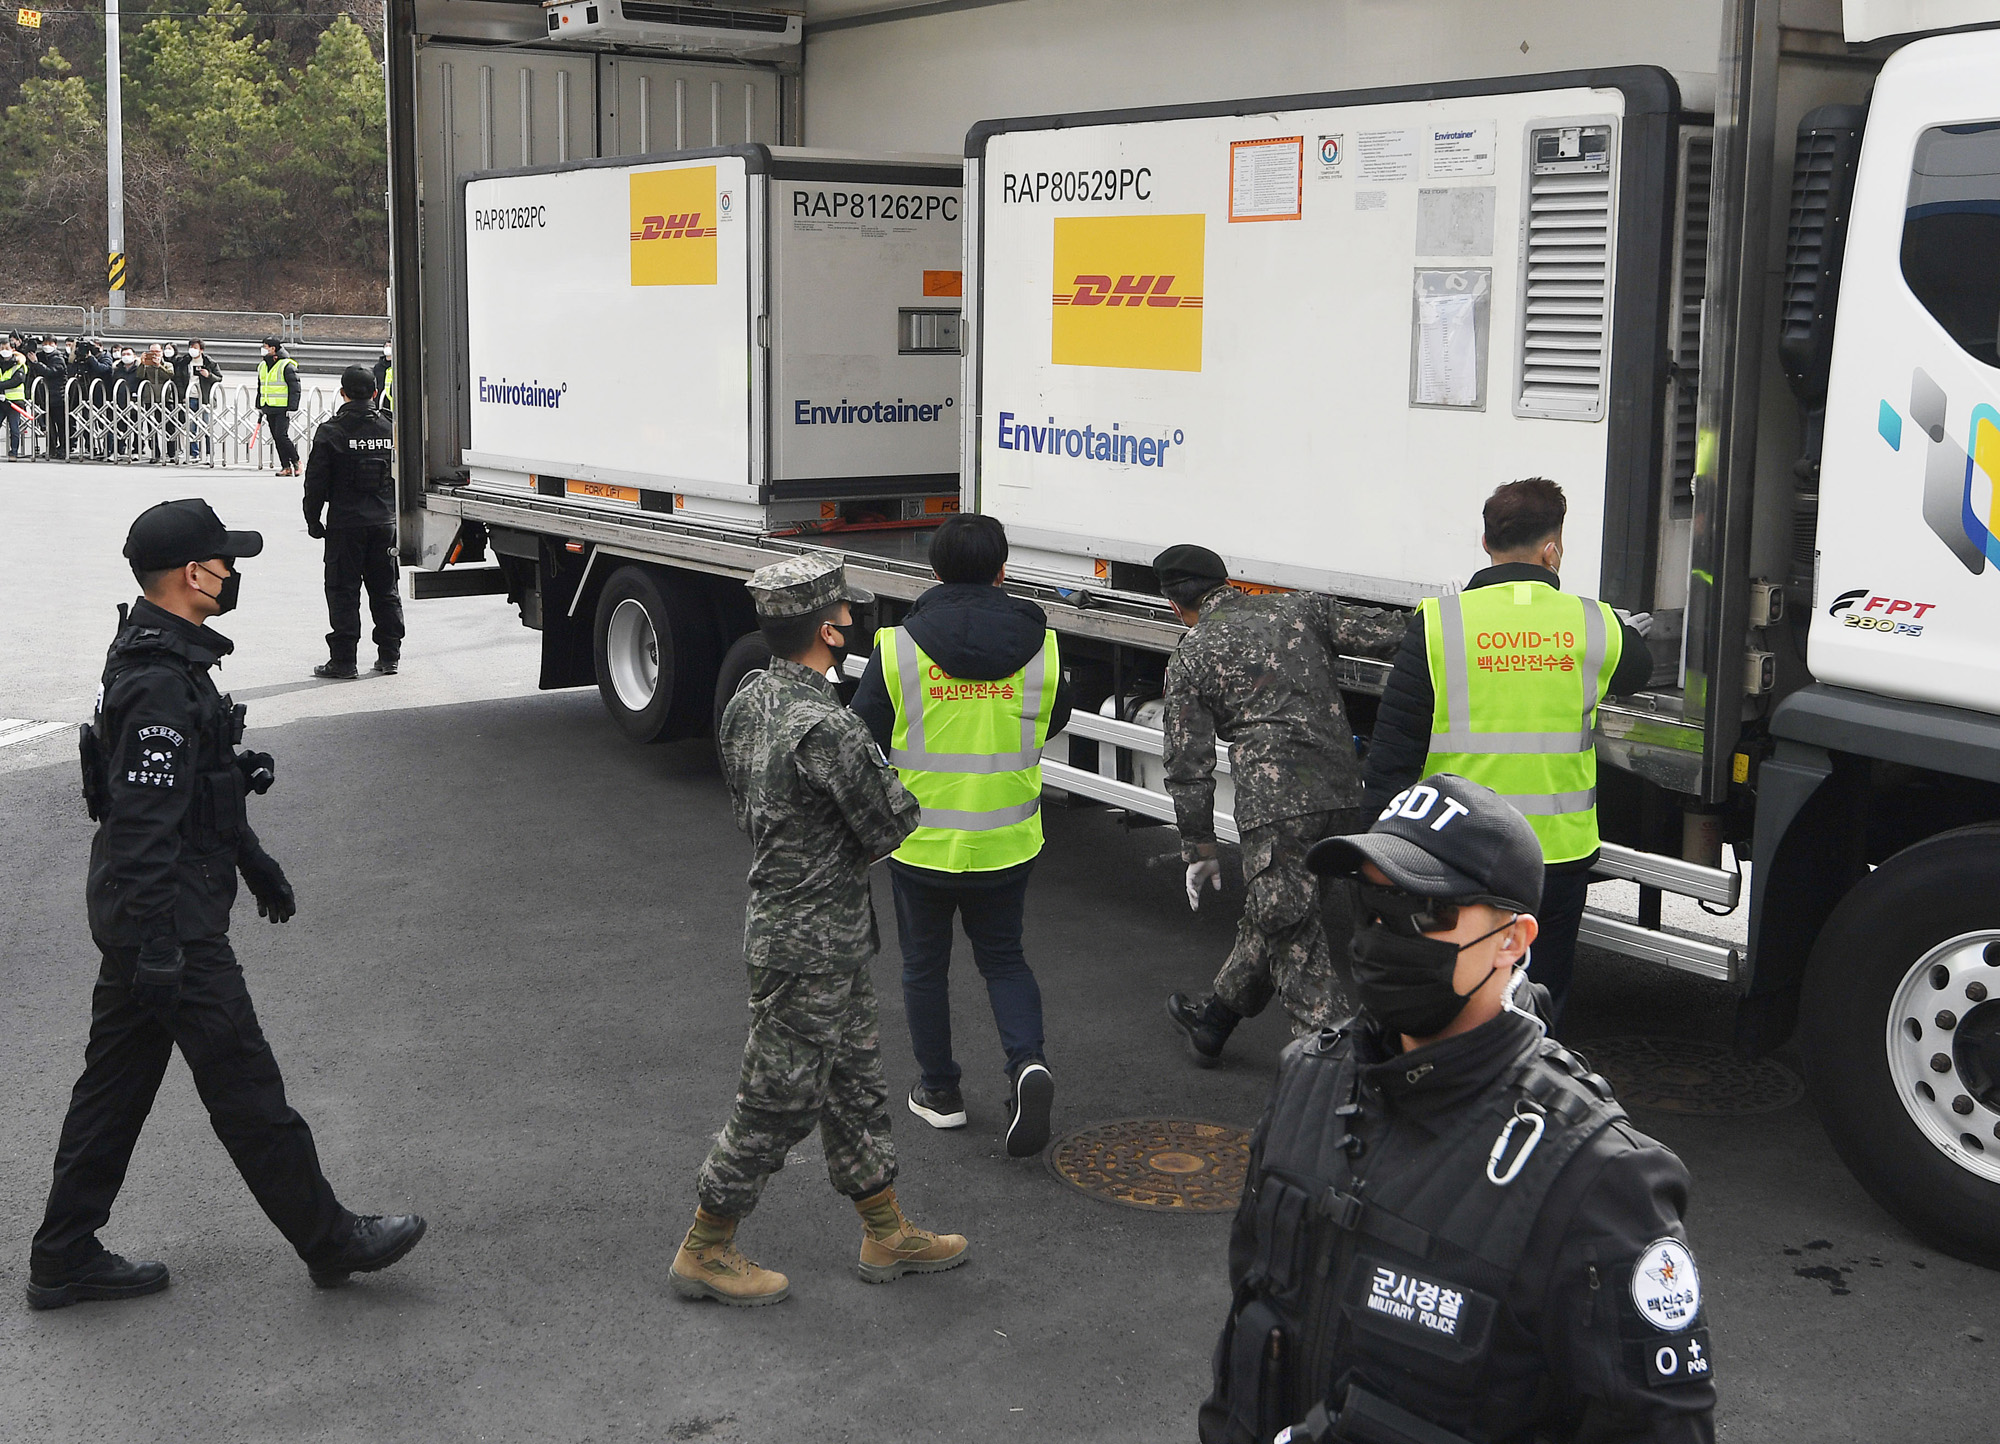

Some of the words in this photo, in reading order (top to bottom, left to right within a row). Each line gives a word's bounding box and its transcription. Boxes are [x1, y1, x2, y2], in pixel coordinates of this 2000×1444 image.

[1003, 167, 1152, 204] RAP80529PC
[475, 205, 546, 232] RAP81262PC
[793, 190, 958, 222] RAP81262PC
[641, 212, 704, 240] DHL
[1070, 274, 1182, 308] DHL
[584, 484, 604, 497] FORK
[605, 486, 621, 498] LIFT
[942, 501, 960, 511] FO
[1863, 596, 1937, 619] FPT
[1476, 631, 1575, 650] COVID-19
[1477, 654, 1575, 673] 백신안전수송
[930, 683, 1014, 701] 백신안전수송
[1378, 785, 1470, 832] SDT
[1372, 1266, 1464, 1320] 군사경찰
[1647, 1288, 1694, 1312] 백신수송
[1367, 1293, 1416, 1321] MILITARY
[1418, 1310, 1457, 1335] POLICE
[1687, 1358, 1708, 1375] POS
